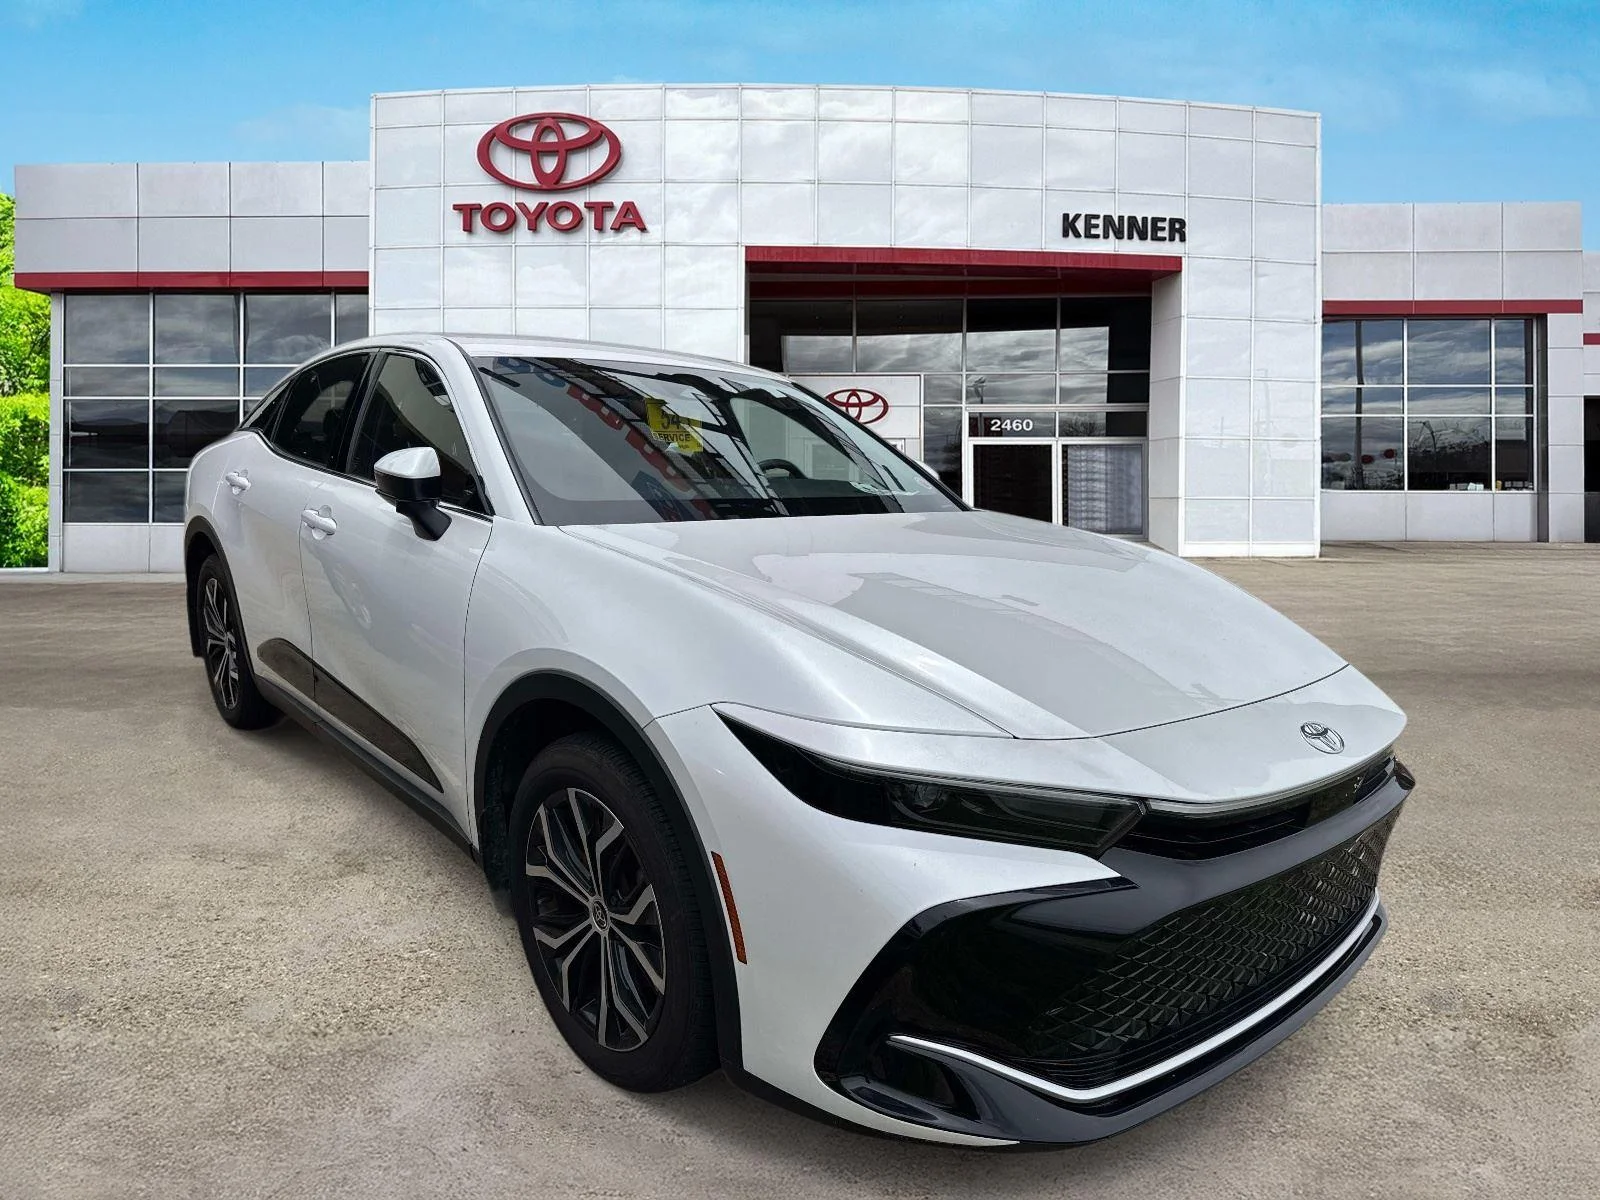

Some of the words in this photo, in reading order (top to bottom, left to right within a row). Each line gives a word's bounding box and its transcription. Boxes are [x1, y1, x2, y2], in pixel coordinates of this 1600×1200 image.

[453, 201, 647, 232] TOYOTA
[1062, 213, 1187, 242] KENNER
[990, 419, 1033, 431] 2460
[652, 432, 690, 443] SERVICE
